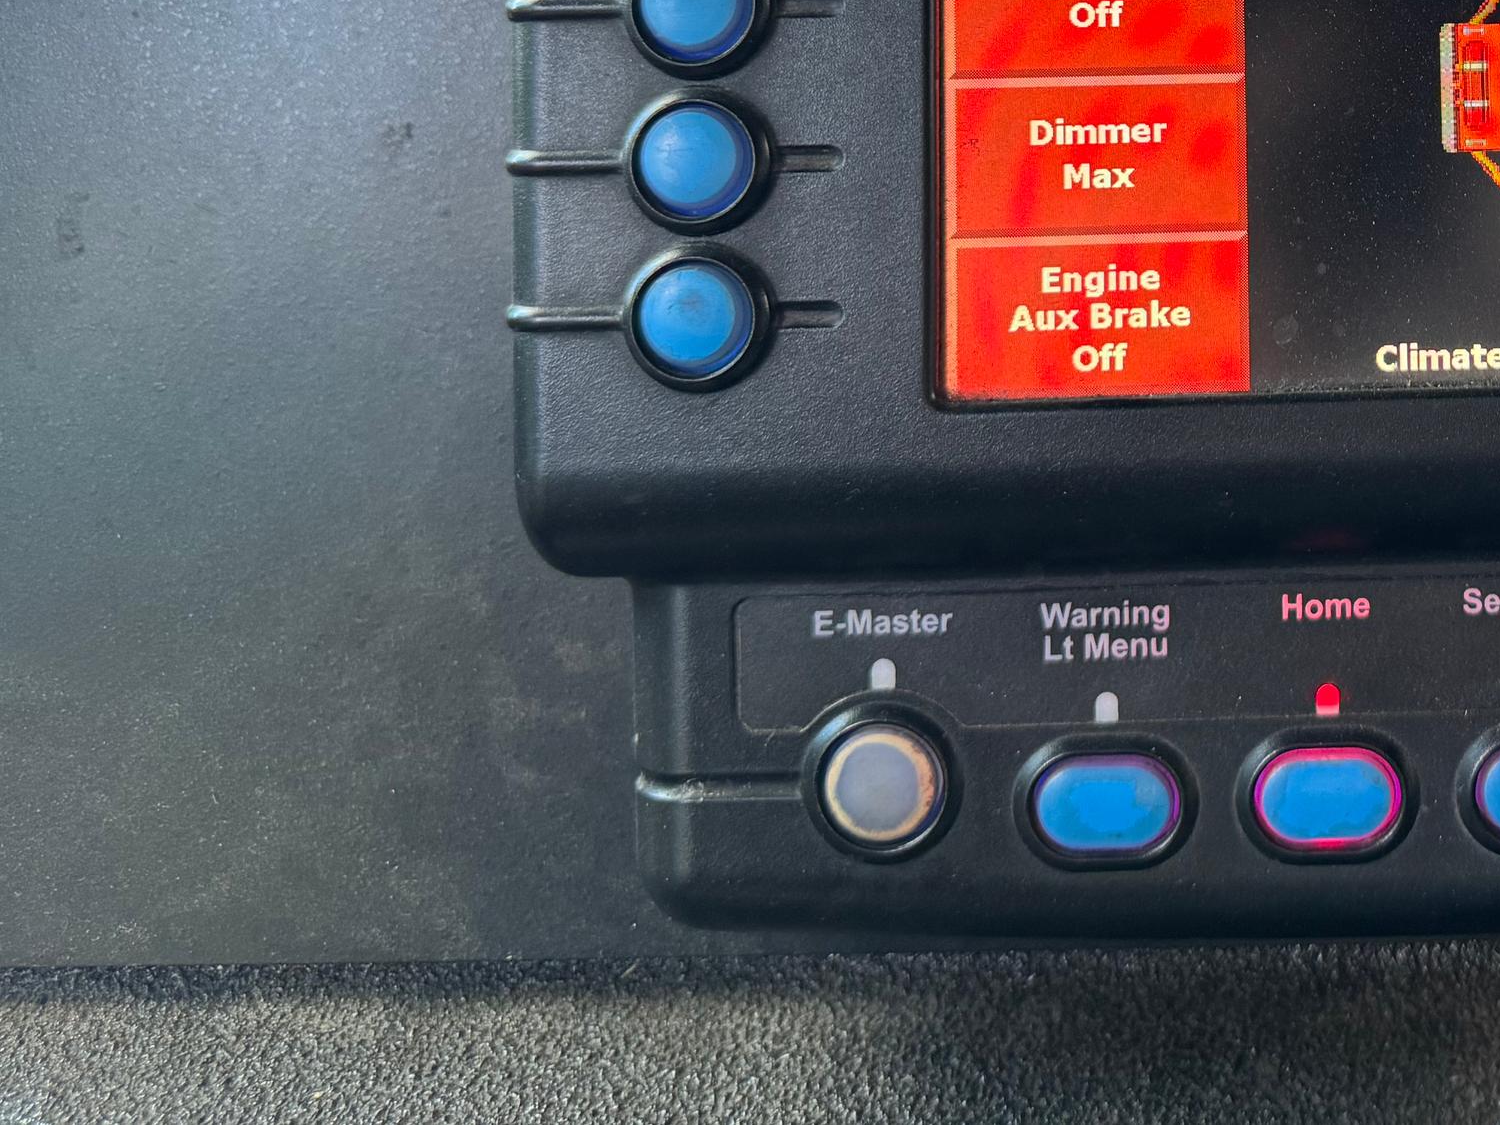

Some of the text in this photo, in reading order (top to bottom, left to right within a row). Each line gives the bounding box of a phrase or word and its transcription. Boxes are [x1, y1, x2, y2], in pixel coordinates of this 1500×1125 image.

[1069, 0, 1124, 28] Off
[1029, 117, 1168, 146] Dimmer
[1063, 163, 1135, 190] Max
[1041, 263, 1161, 298] Engine
[1008, 299, 1191, 332] Aux Brake
[1072, 342, 1128, 372] Off
[1040, 599, 1170, 632] Warning
[1281, 593, 1371, 621] Home
[813, 609, 953, 637] E-Master
[1044, 633, 1168, 662] Lt Menu
